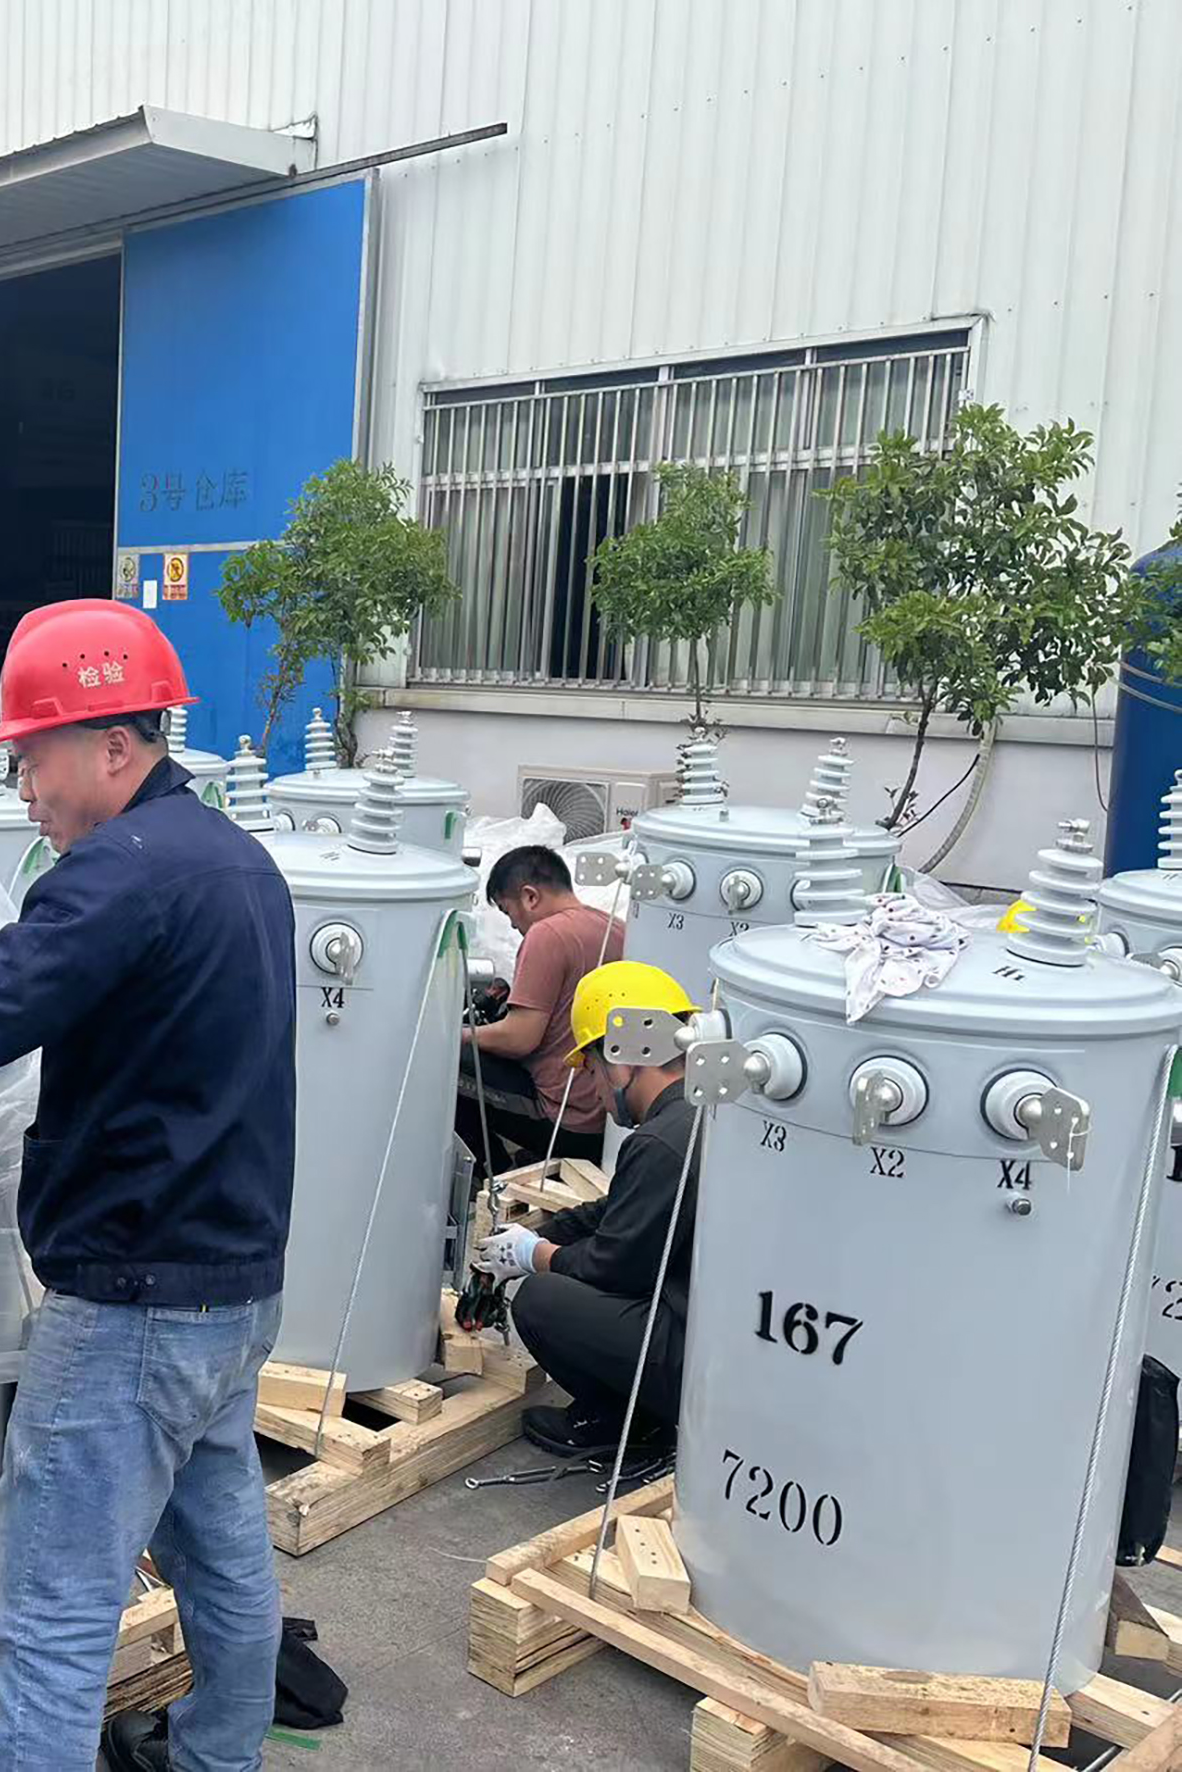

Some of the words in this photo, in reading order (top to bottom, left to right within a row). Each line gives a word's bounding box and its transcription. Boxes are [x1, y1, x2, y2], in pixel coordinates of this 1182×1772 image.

[140, 471, 248, 511] 3号仓库
[78, 661, 125, 688] 检验
[667, 911, 685, 930] X3
[321, 986, 345, 1009] X4
[760, 1120, 787, 1152] X3
[870, 1146, 905, 1178] X2
[997, 1158, 1032, 1190] X4
[755, 1290, 864, 1366] 167
[722, 1448, 843, 1546] 7200
